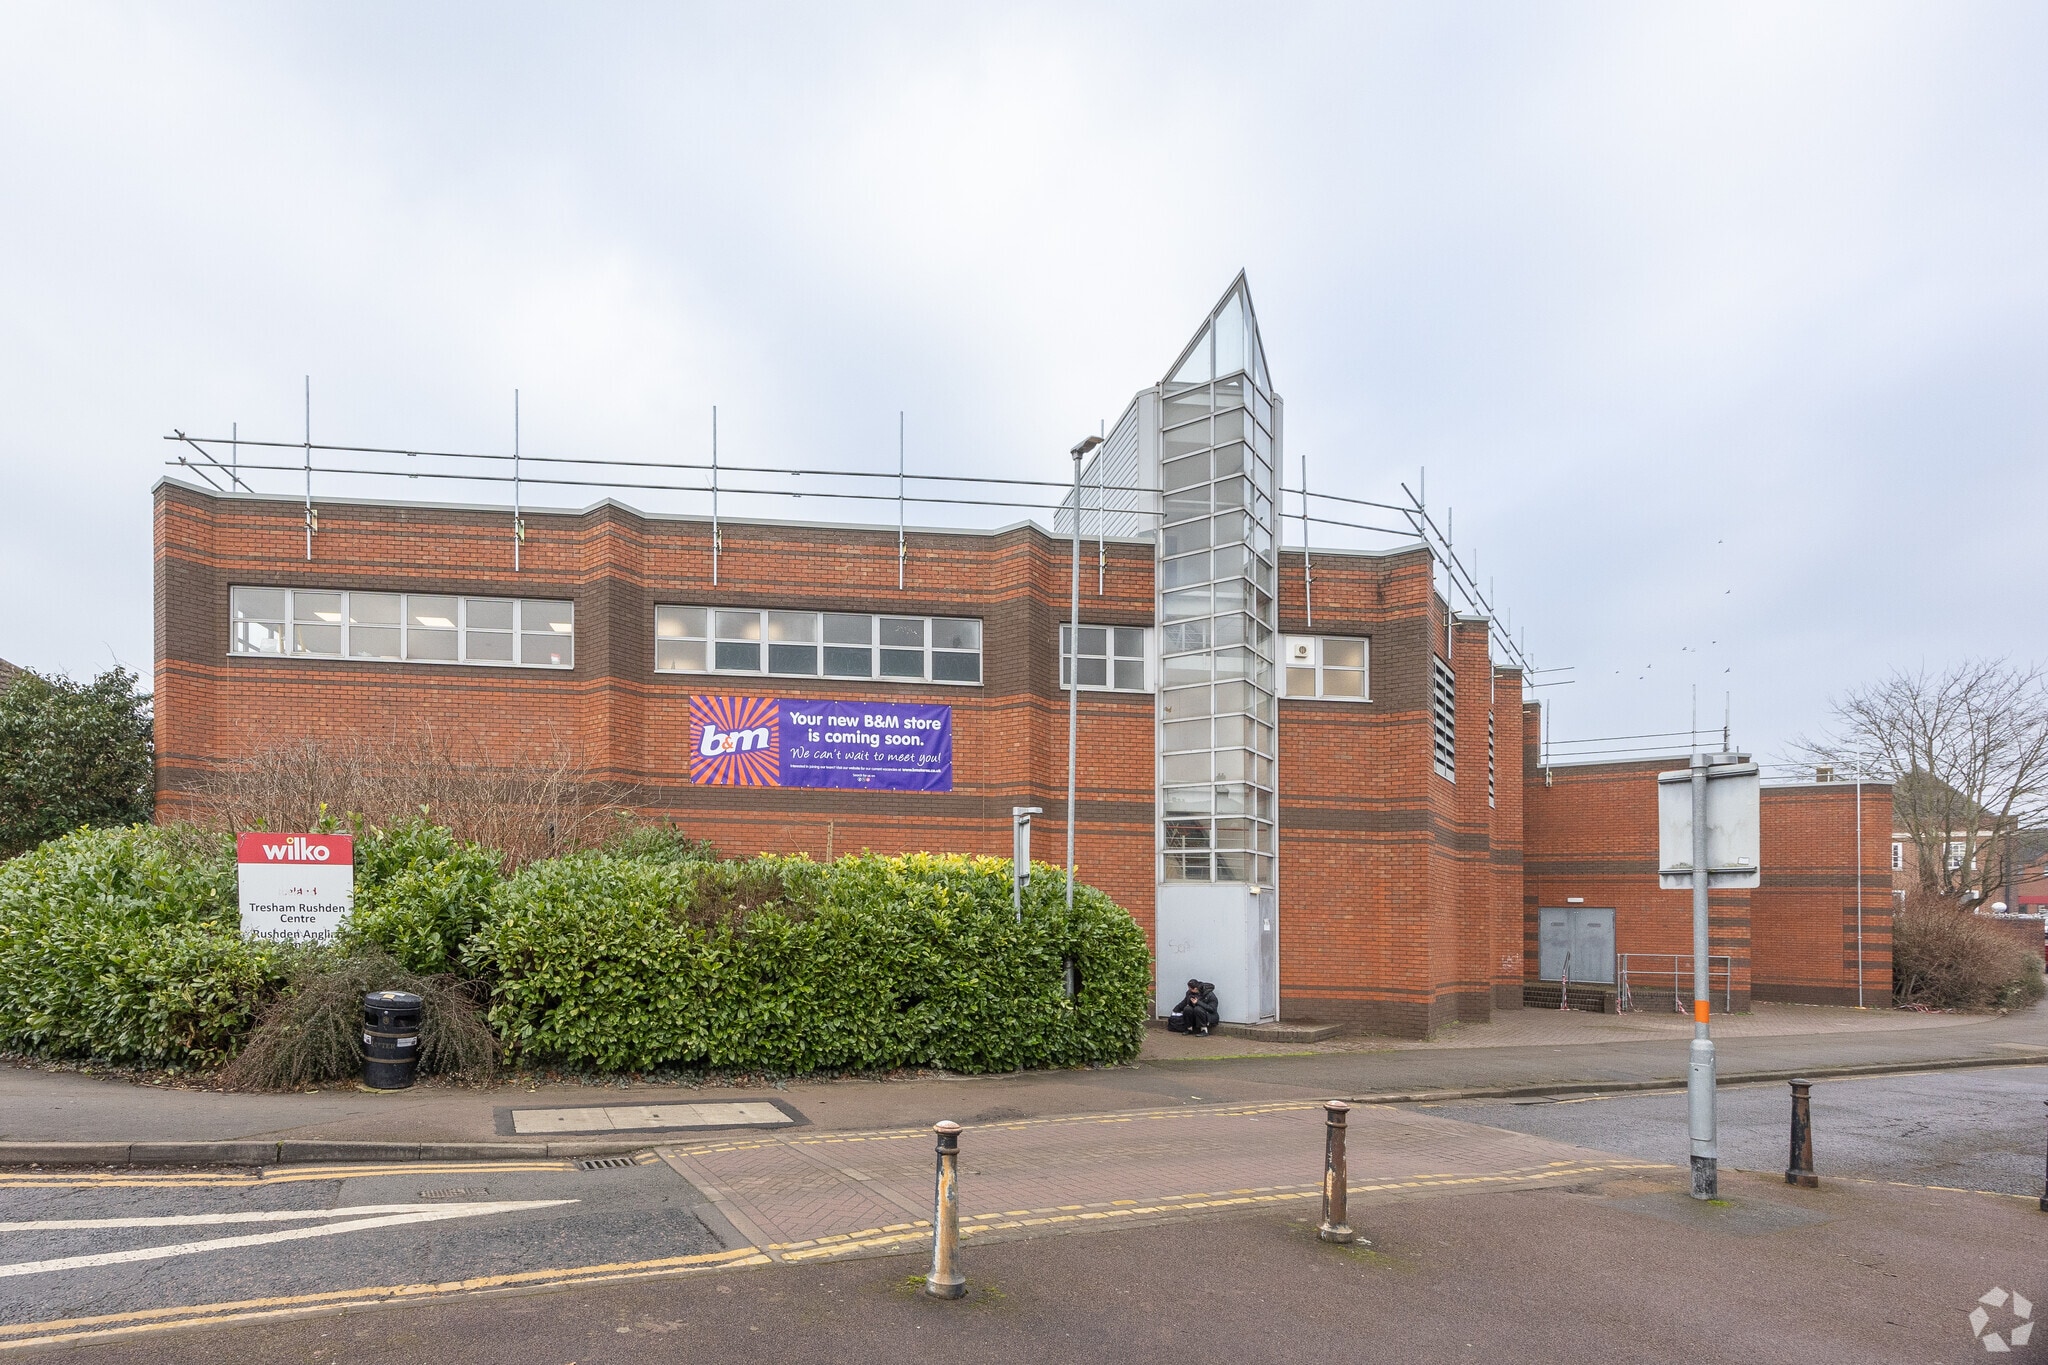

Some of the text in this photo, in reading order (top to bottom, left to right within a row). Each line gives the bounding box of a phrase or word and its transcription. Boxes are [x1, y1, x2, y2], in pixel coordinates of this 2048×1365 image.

[789, 711, 942, 730] Your new B&M store
[808, 728, 924, 748] is coming soon.
[790, 745, 942, 766] We can't wait to meet you!
[262, 836, 330, 861] wilko
[249, 903, 346, 913] Tresham Rushden
[280, 914, 316, 923] Centre
[253, 929, 300, 939] Rushden
